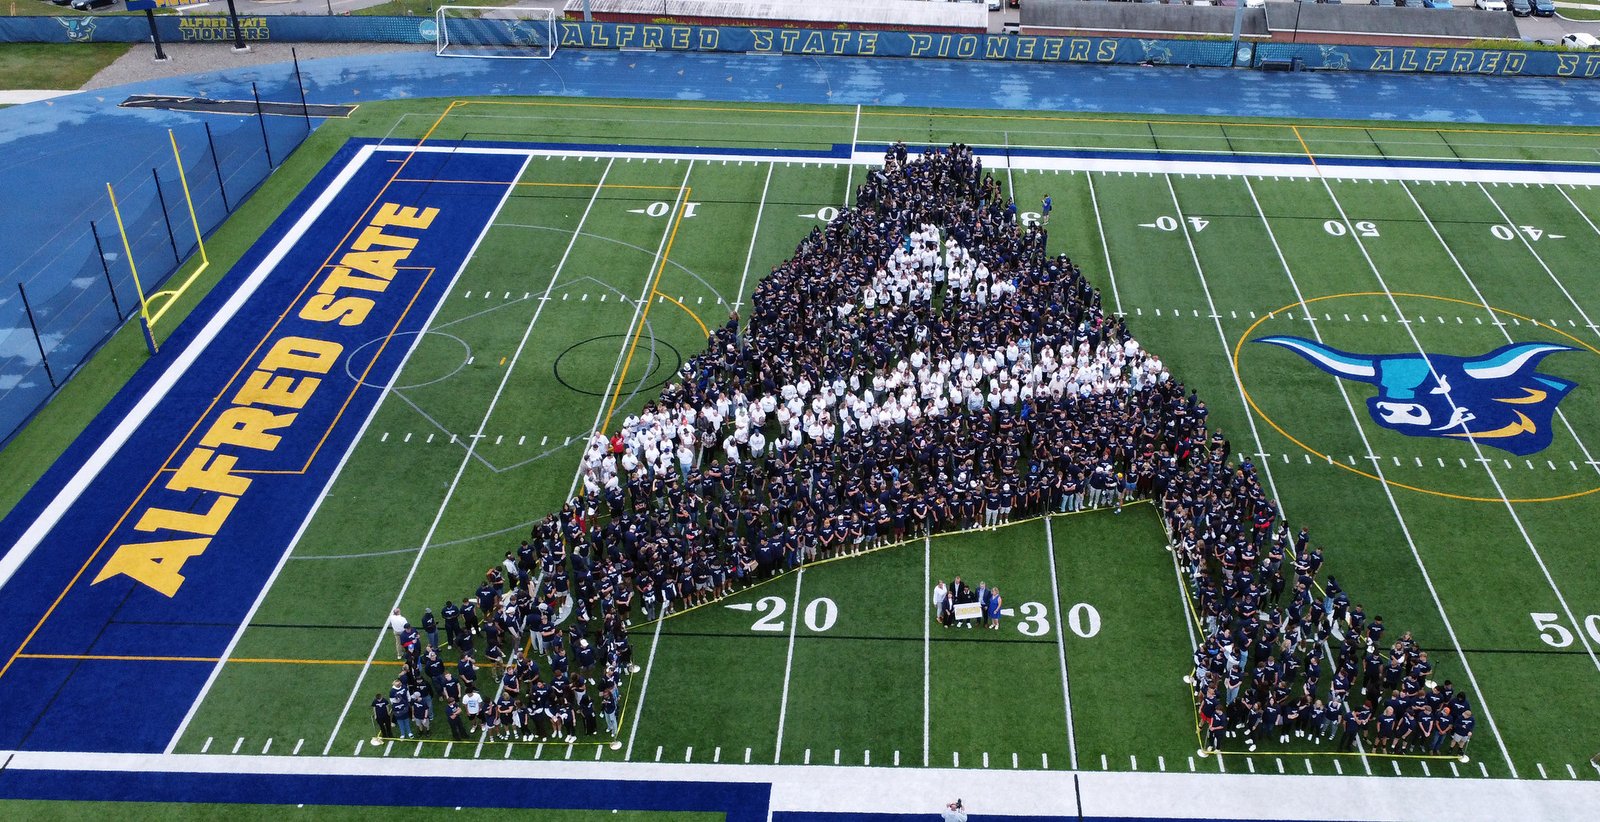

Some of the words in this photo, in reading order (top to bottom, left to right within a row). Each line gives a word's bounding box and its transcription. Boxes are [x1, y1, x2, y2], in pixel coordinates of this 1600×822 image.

[180, 17, 228, 27] ALFRED
[230, 17, 267, 27] TATE
[561, 23, 719, 50] ALFRED
[750, 29, 879, 55] STATE
[908, 34, 1118, 61] PIONEERS
[1370, 49, 1527, 74] ALFRED
[90, 336, 344, 598] ALFRED
[298, 203, 441, 326] STATE
[750, 596, 838, 631] 20
[1017, 602, 1101, 638] 30
